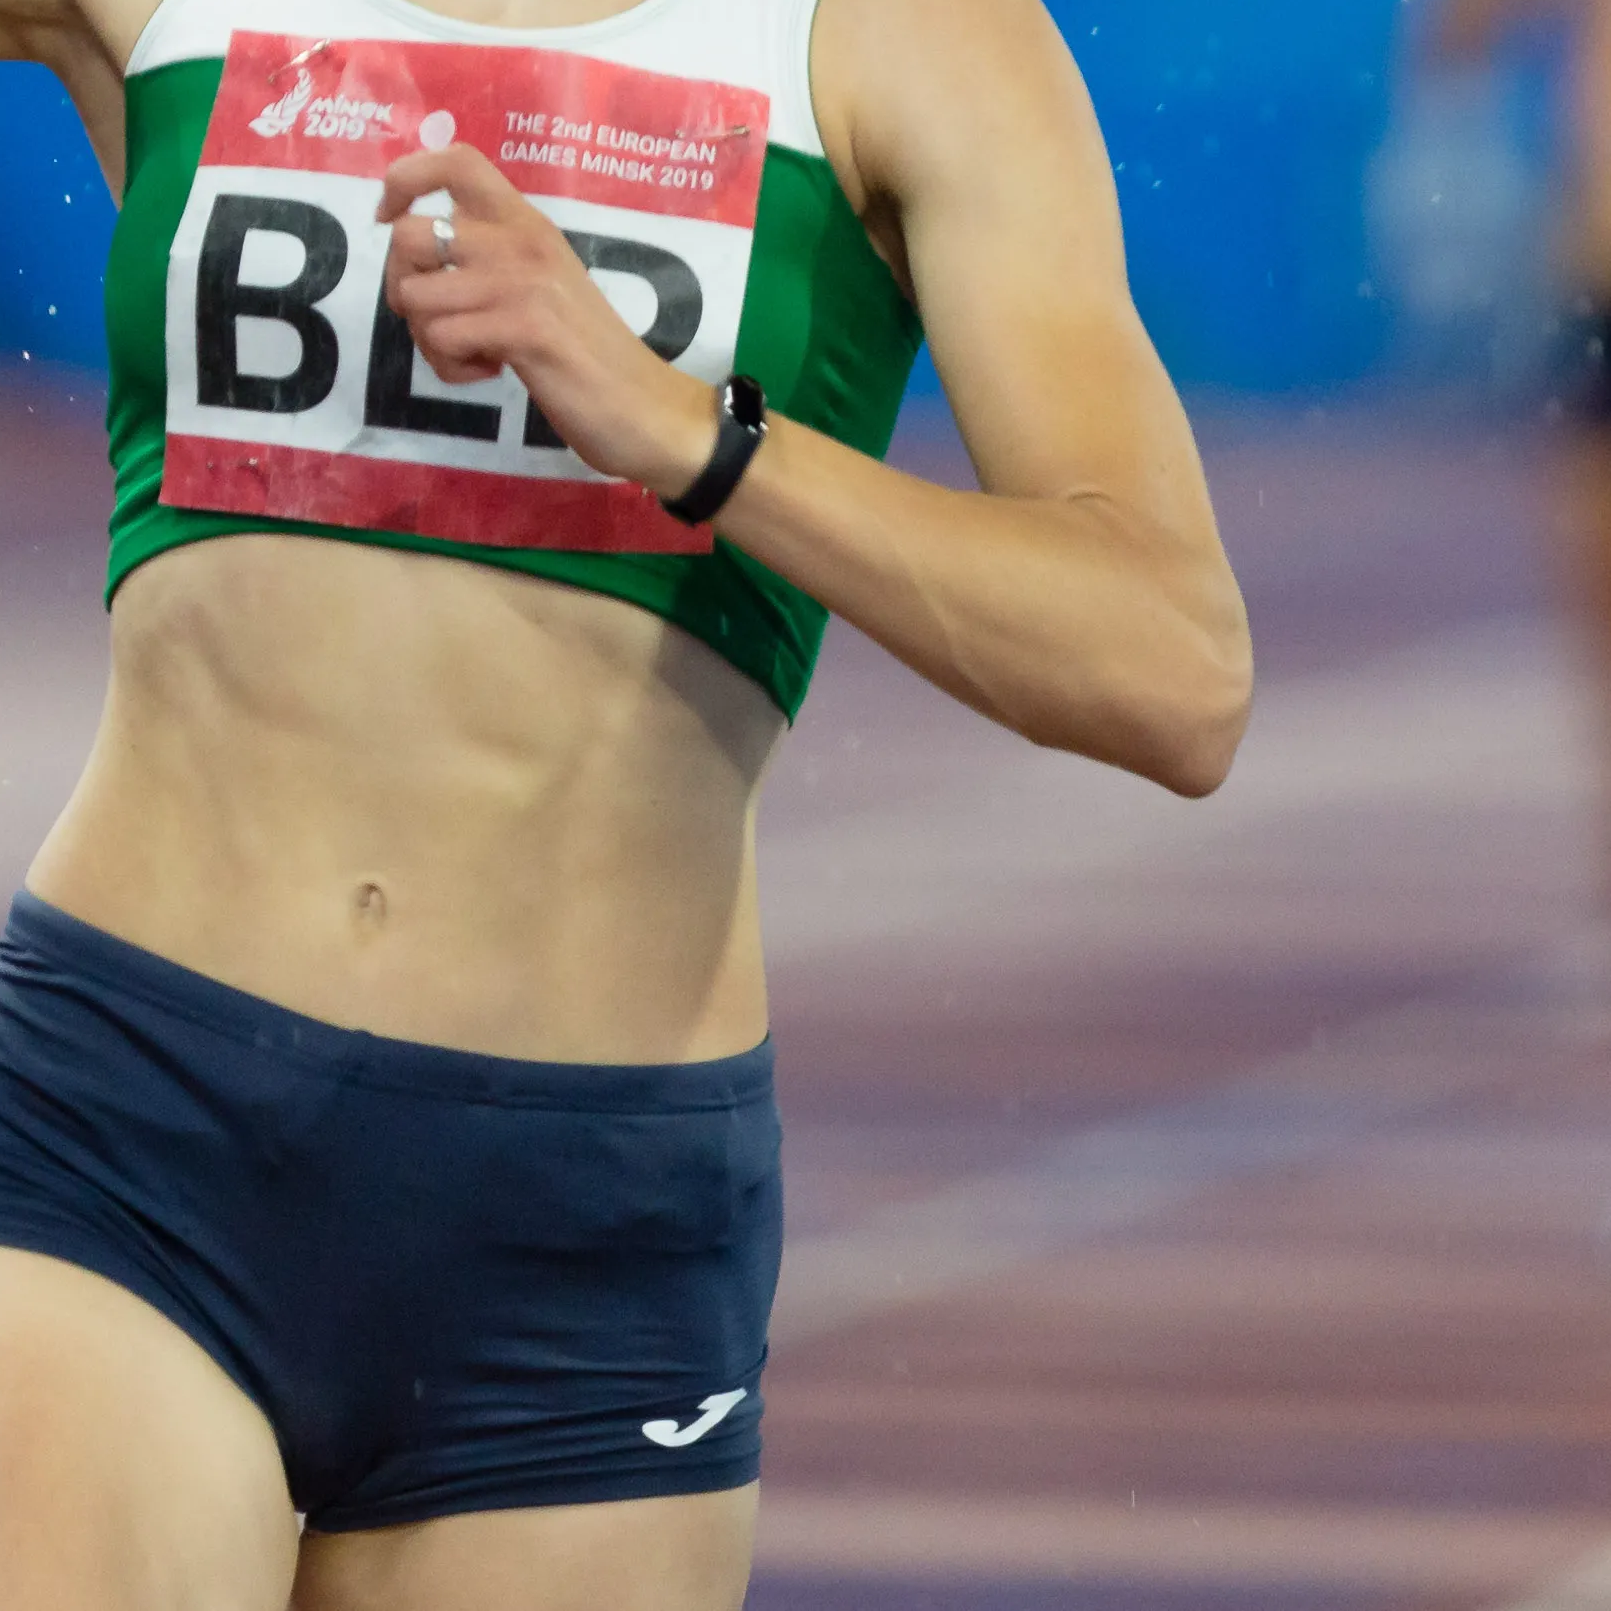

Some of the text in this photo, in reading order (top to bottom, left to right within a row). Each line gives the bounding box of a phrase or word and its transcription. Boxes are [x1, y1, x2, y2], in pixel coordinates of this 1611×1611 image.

[303, 113, 366, 141] 2019
[506, 111, 717, 164] THE 2nd EUROPEAN
[500, 141, 714, 190] GAMES MINSK 2019
